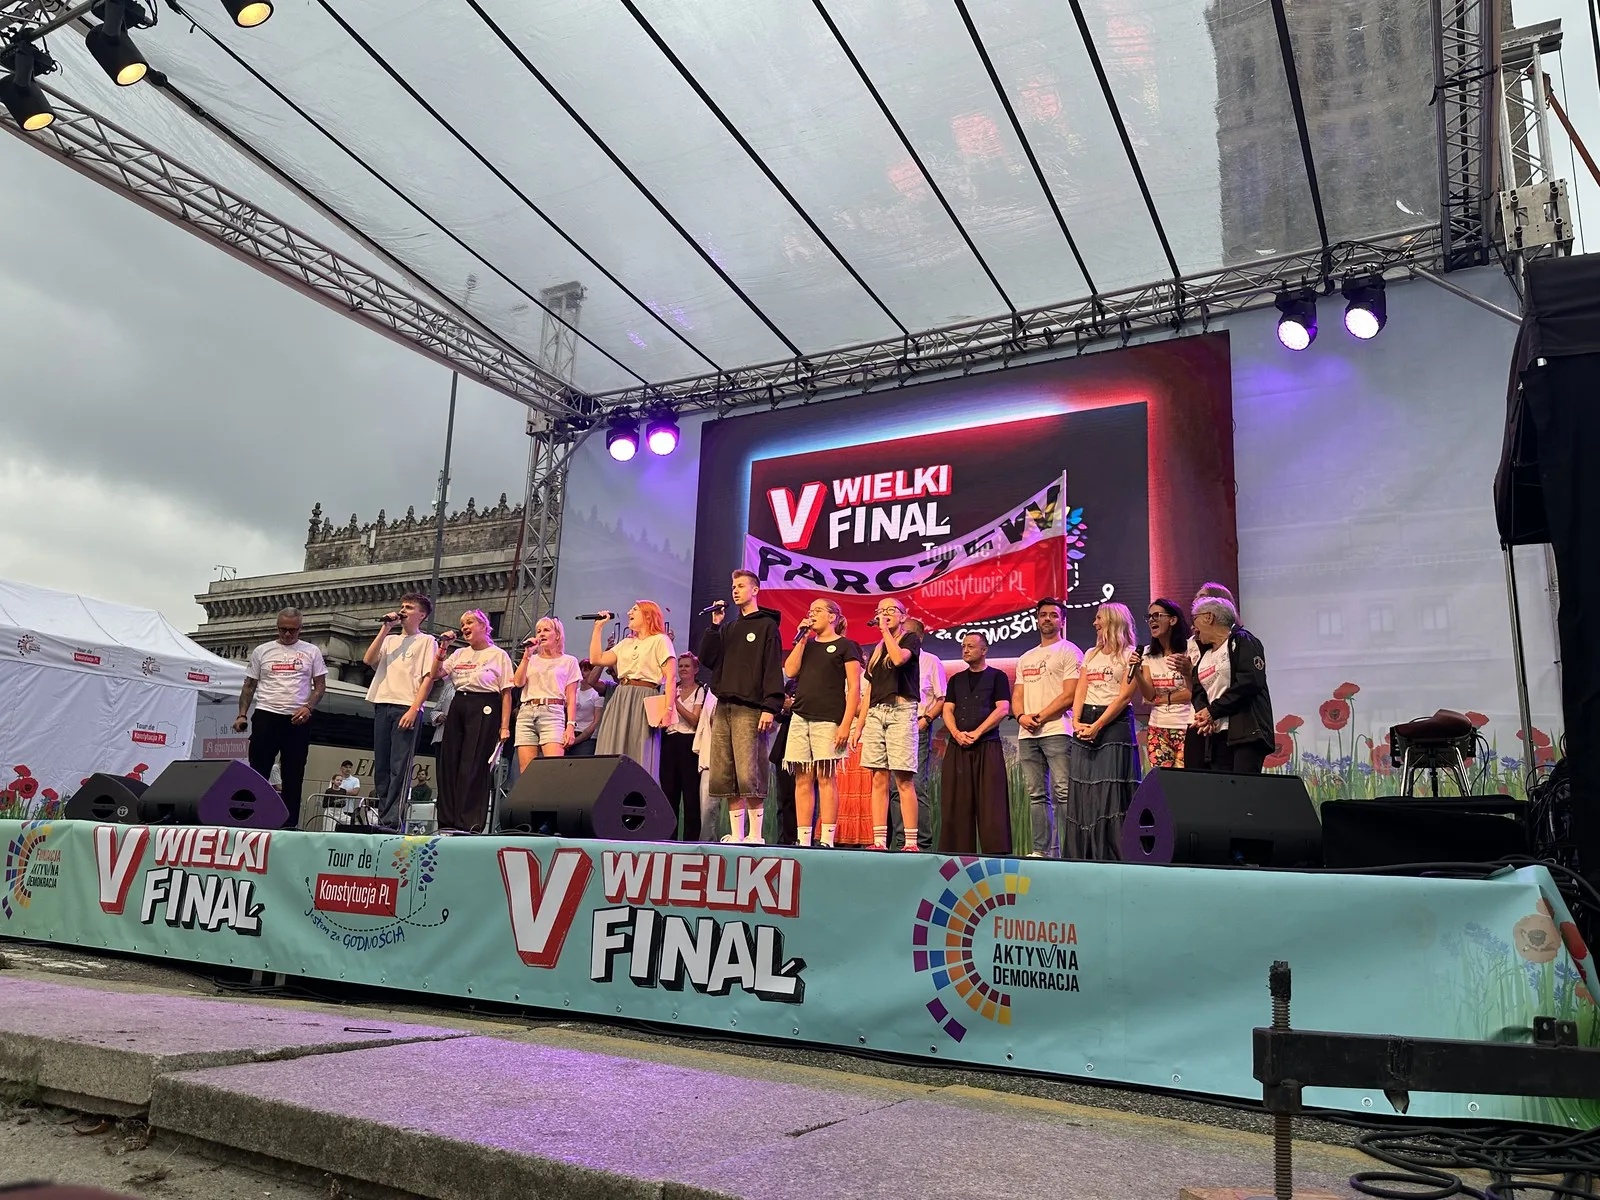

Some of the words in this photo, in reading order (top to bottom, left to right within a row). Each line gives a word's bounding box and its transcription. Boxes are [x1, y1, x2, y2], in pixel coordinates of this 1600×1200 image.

[767, 482, 828, 550] V
[833, 465, 952, 507] WIELKI
[1009, 570, 1026, 592] PL
[94, 825, 150, 914] V
[155, 827, 272, 874] WIELKI
[328, 848, 353, 868] Tour
[358, 848, 372, 869] de
[27, 876, 57, 888] DEMOKRACJA
[319, 879, 377, 908] Konstytucja
[378, 883, 391, 906] PL
[304, 907, 330, 934] Jestem
[498, 848, 595, 969] V
[601, 851, 802, 918] WIELKI
[994, 916, 1078, 945] FUNDACJA
[993, 943, 1079, 971] AKTYWNA
[993, 966, 1080, 992] DEMOKRACJA
